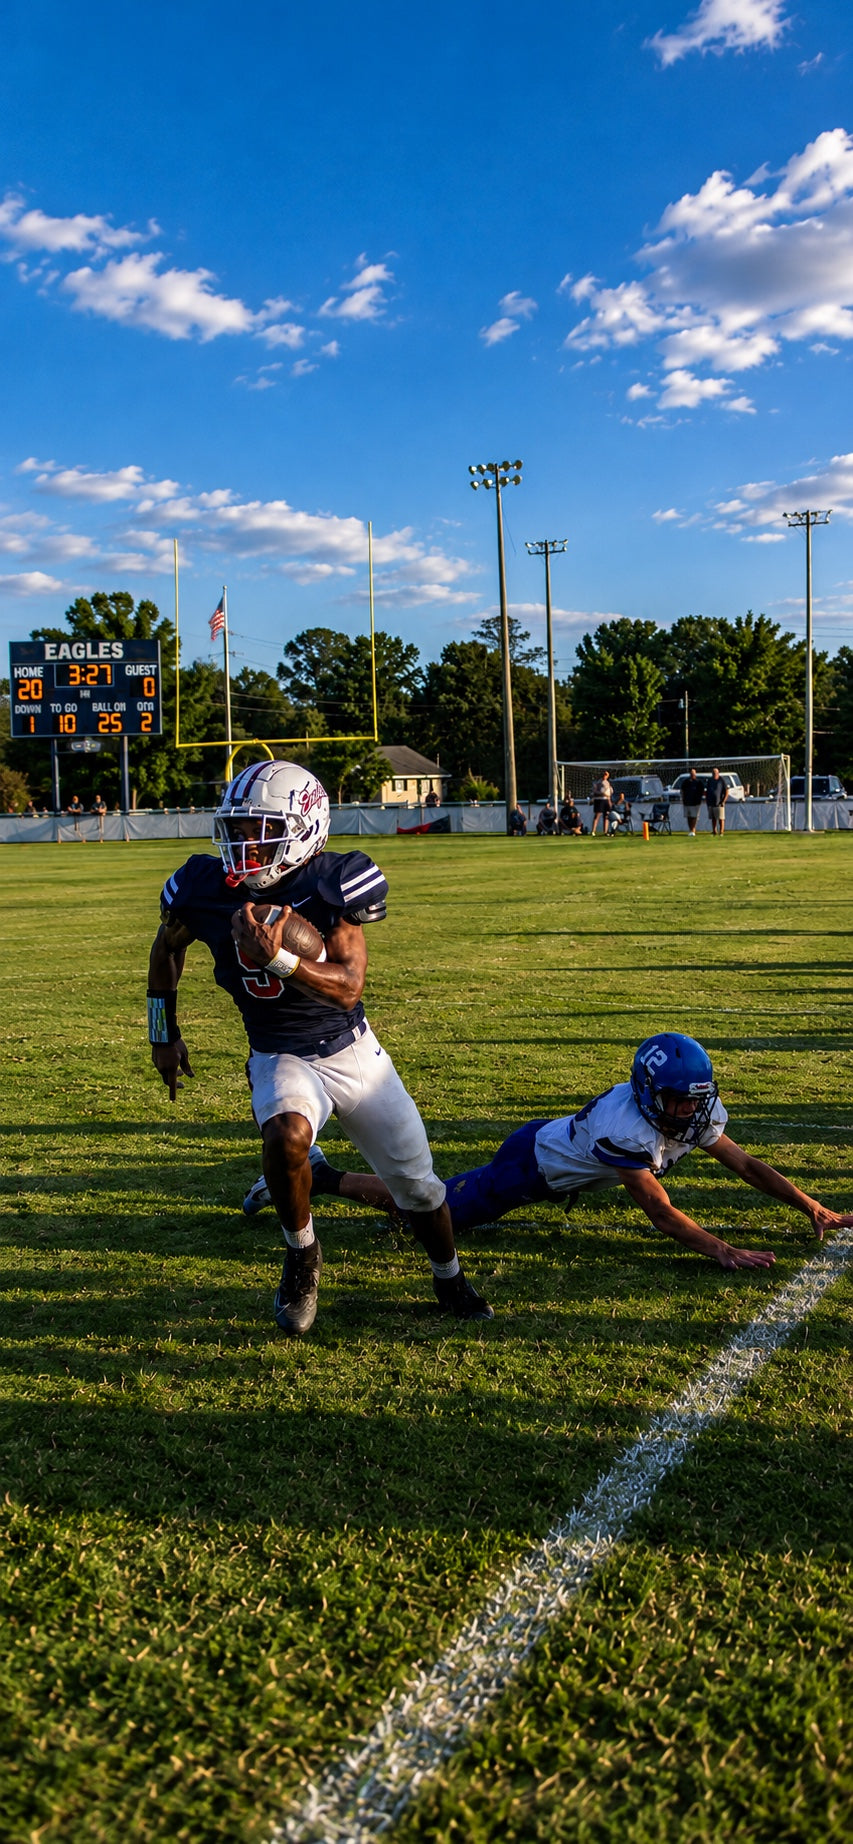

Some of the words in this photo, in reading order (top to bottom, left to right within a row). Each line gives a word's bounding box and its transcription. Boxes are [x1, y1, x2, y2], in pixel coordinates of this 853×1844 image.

[44, 642, 124, 660] EAGLES
[14, 667, 43, 678] HOME
[69, 664, 112, 685] 3:27
[125, 664, 157, 676] GUEST
[18, 679, 43, 700] 20
[143, 677, 155, 697] 0
[14, 704, 41, 714] DOWN
[50, 703, 61, 713] TO
[64, 703, 78, 713] GO
[92, 702, 113, 712] BALL
[30, 716, 35, 733] 1
[59, 714, 76, 733] 10
[98, 713, 123, 733] 25
[141, 712, 152, 732] 2
[640, 1044, 668, 1076] 12
